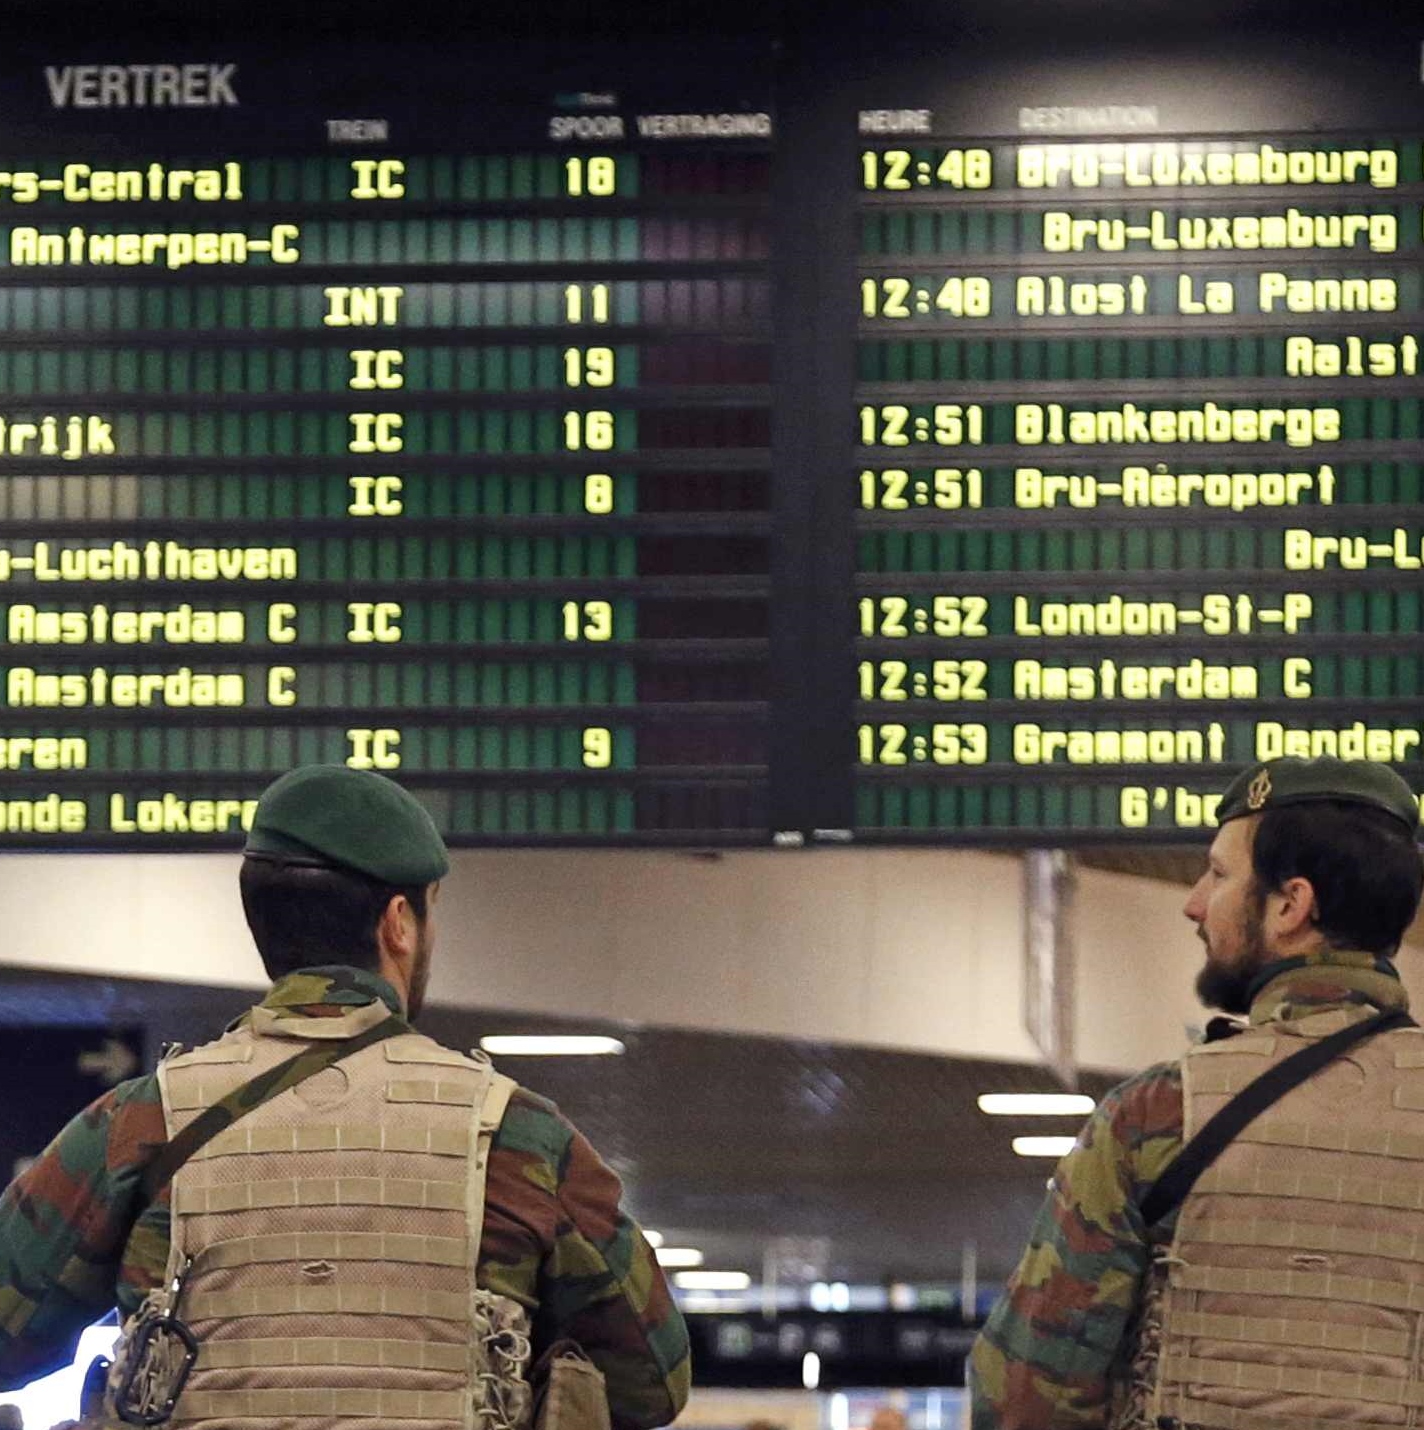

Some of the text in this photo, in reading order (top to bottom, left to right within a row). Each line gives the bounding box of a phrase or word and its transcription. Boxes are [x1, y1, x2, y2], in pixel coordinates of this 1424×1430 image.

[44, 64, 240, 107] VERTREK
[326, 119, 389, 142] TREIN
[550, 117, 624, 140] SPOOR
[638, 114, 773, 138] VERTRAGING
[858, 110, 932, 133] HEURE
[351, 159, 404, 199] IC
[566, 156, 615, 196] 18
[863, 148, 991, 189] 12:48
[1016, 145, 1399, 187] Bru-Luxembourg
[11, 223, 299, 269] Antwerpen-C
[1043, 208, 1397, 252] Bru-Luxemburg
[324, 287, 403, 326] INT
[565, 285, 608, 322] 11
[862, 277, 991, 317] 12:48
[1016, 276, 1146, 315] Alost
[1179, 275, 1234, 314] La
[1259, 271, 1397, 312] Panne
[349, 349, 403, 389] IC
[565, 346, 613, 386] 19
[1286, 334, 1418, 376] Aalst
[349, 412, 403, 452] IC
[565, 410, 613, 450] 16
[861, 404, 982, 445] 12:51
[1016, 402, 1340, 447] Blankenberge
[348, 475, 402, 516] IC
[585, 473, 613, 514] 8
[861, 468, 982, 509] 12:51
[8, 603, 244, 644] Amsterdam
[268, 602, 296, 643] C
[347, 601, 401, 642] IC
[563, 600, 612, 641] 13
[860, 595, 987, 637] 12:52
[1015, 592, 1312, 636] London-St-P
[8, 666, 244, 706] Amsterdam
[268, 665, 296, 706] C
[860, 659, 987, 700] 12:52
[1014, 658, 1257, 700] Amsterdam
[1284, 657, 1312, 698] C
[346, 728, 400, 770] IC
[583, 727, 611, 768] 9
[859, 723, 987, 764] 12:53
[1014, 722, 1225, 764] Grammont
